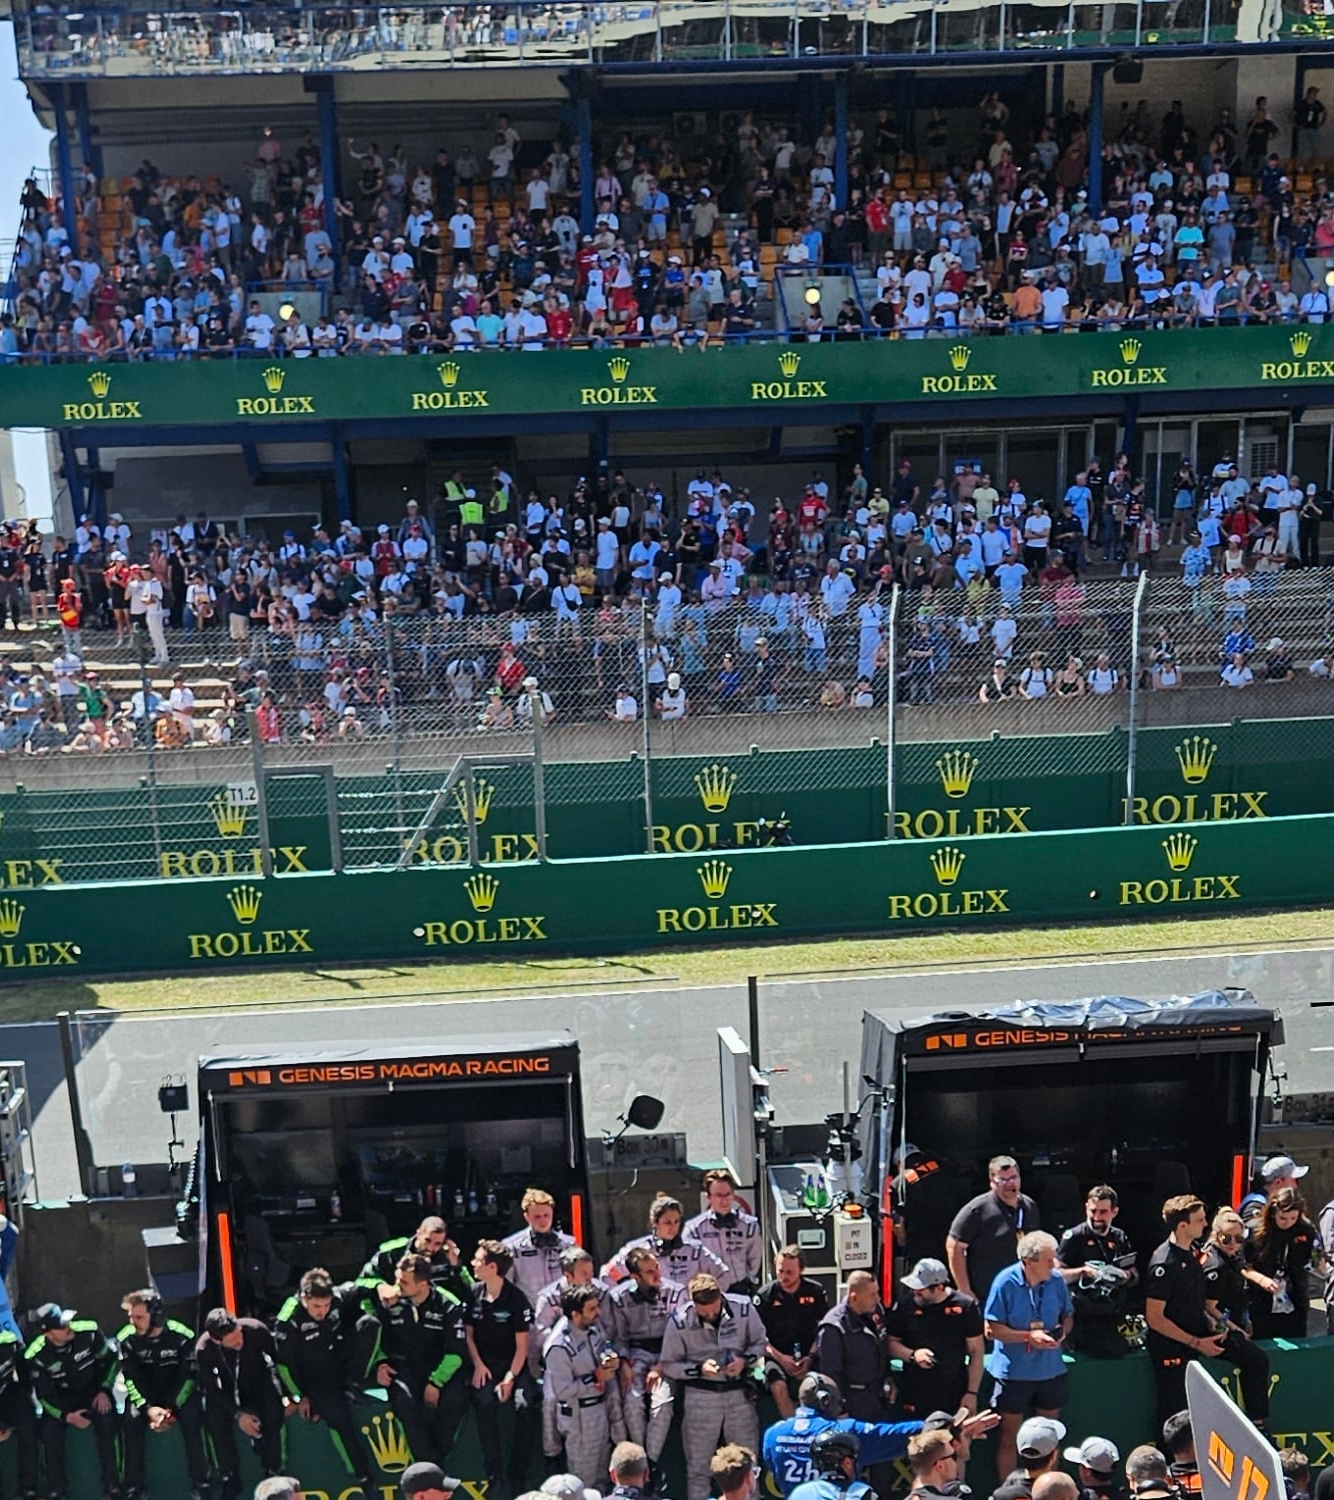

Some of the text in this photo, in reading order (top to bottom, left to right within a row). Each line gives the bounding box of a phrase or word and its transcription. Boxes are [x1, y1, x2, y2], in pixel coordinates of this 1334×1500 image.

[921, 374, 998, 393] ROLEX
[1091, 367, 1167, 386] ROLEX
[411, 390, 489, 410] ROLEX
[581, 386, 658, 405] ROLEX
[751, 380, 828, 399] ROLEX
[63, 401, 142, 421] ROLEX
[237, 396, 316, 415] ROLEX
[229, 786, 257, 802] T1.2
[1122, 791, 1268, 825] ROLEX
[884, 806, 1033, 839] ROLEX
[1119, 875, 1240, 905] ROLEX
[889, 889, 1010, 919] ROLEX
[656, 903, 779, 933] ROLEX
[422, 916, 547, 946] ROLEX
[188, 929, 314, 959] ROLEX
[279, 1058, 550, 1083] GENESIS MAGMA RACING
